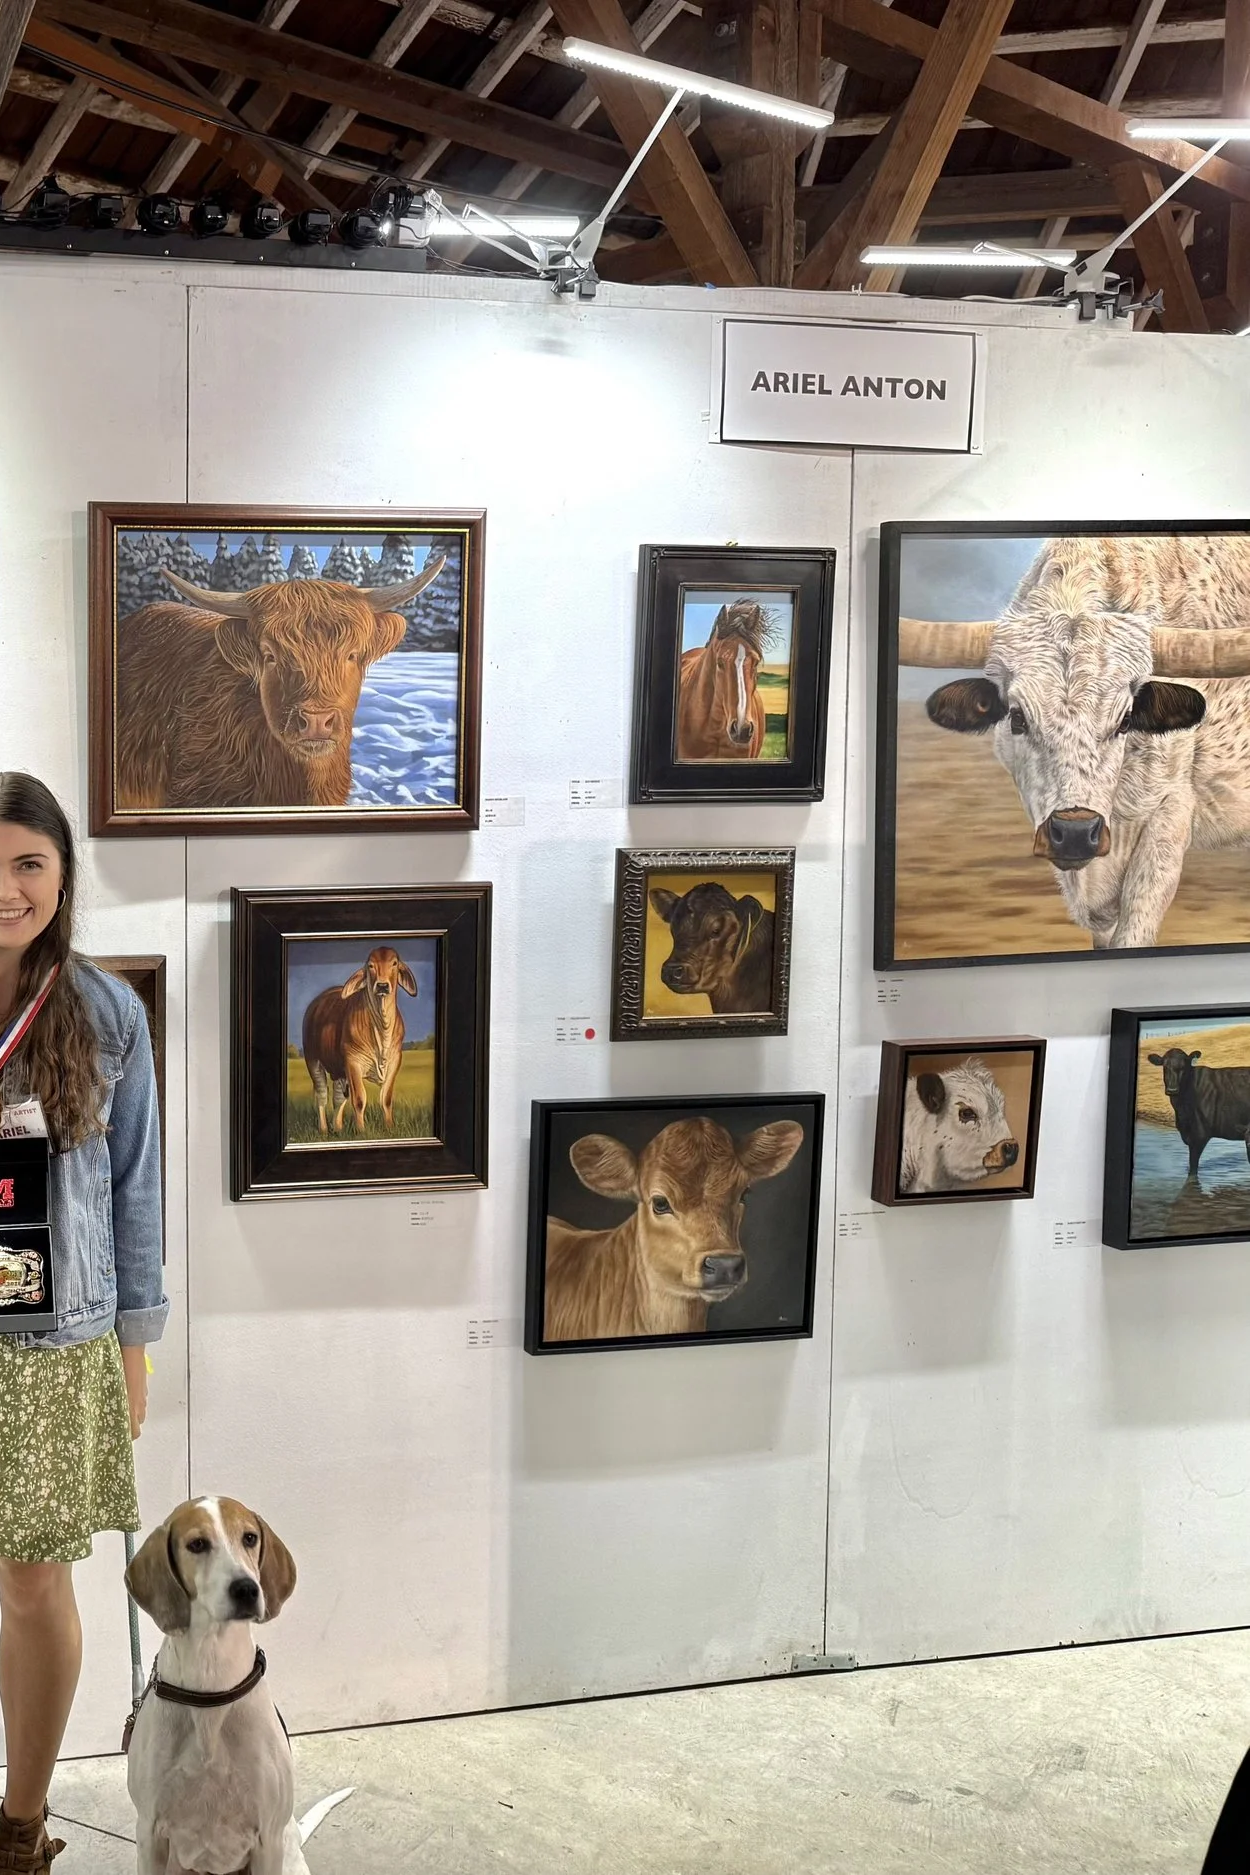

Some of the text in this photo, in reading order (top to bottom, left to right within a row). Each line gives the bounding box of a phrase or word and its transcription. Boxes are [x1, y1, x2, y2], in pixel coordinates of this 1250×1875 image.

[750, 370, 947, 401] ARIEL ANTON
[13, 1107, 37, 1116] ARTIST
